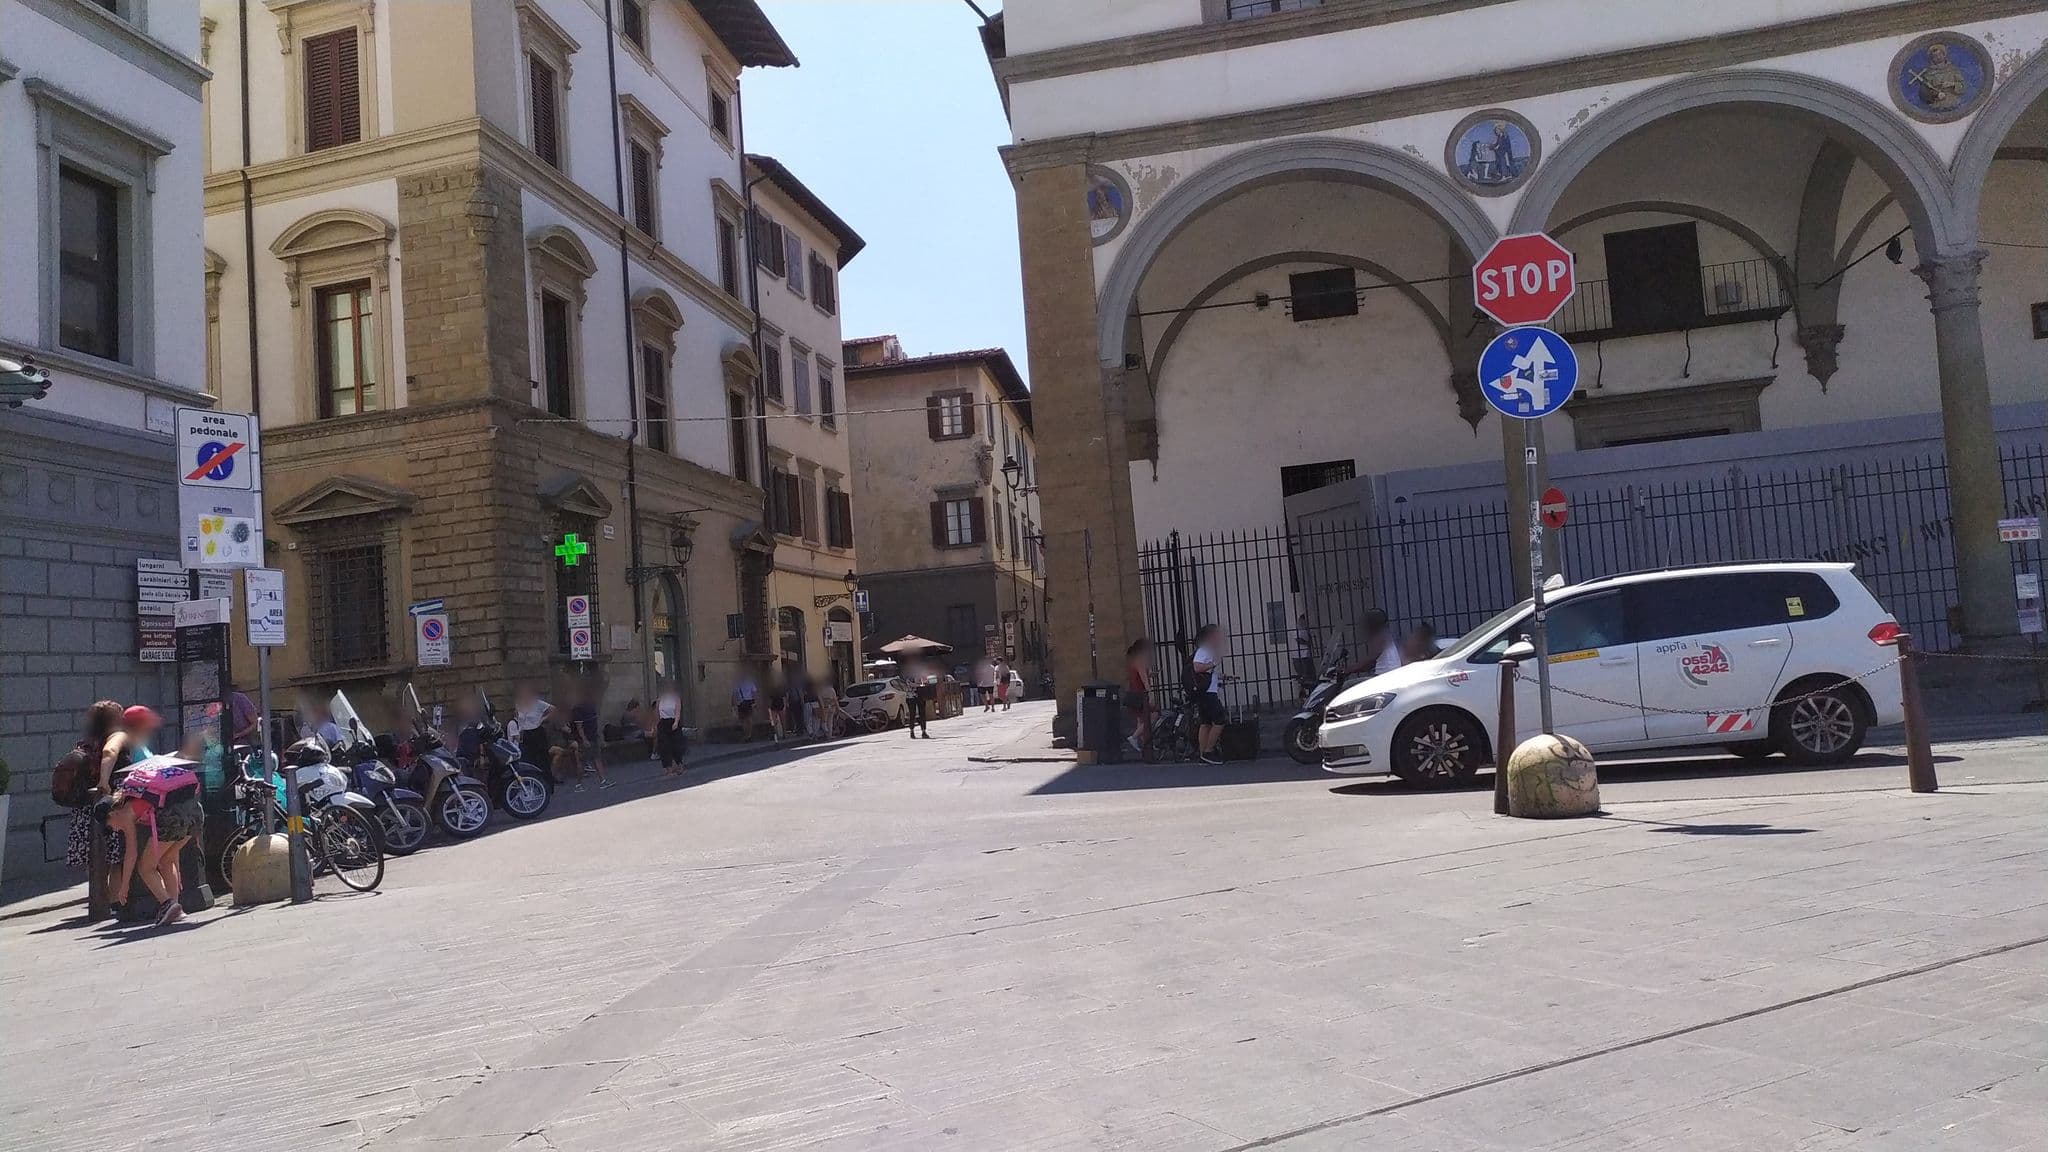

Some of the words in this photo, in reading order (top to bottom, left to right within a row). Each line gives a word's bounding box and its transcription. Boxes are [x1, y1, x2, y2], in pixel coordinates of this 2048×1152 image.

[1481, 260, 1566, 301] STOP
[202, 415, 226, 425] area
[190, 426, 239, 439] pedonale
[1682, 655, 1708, 665] 055
[1692, 663, 1729, 674] 4242
